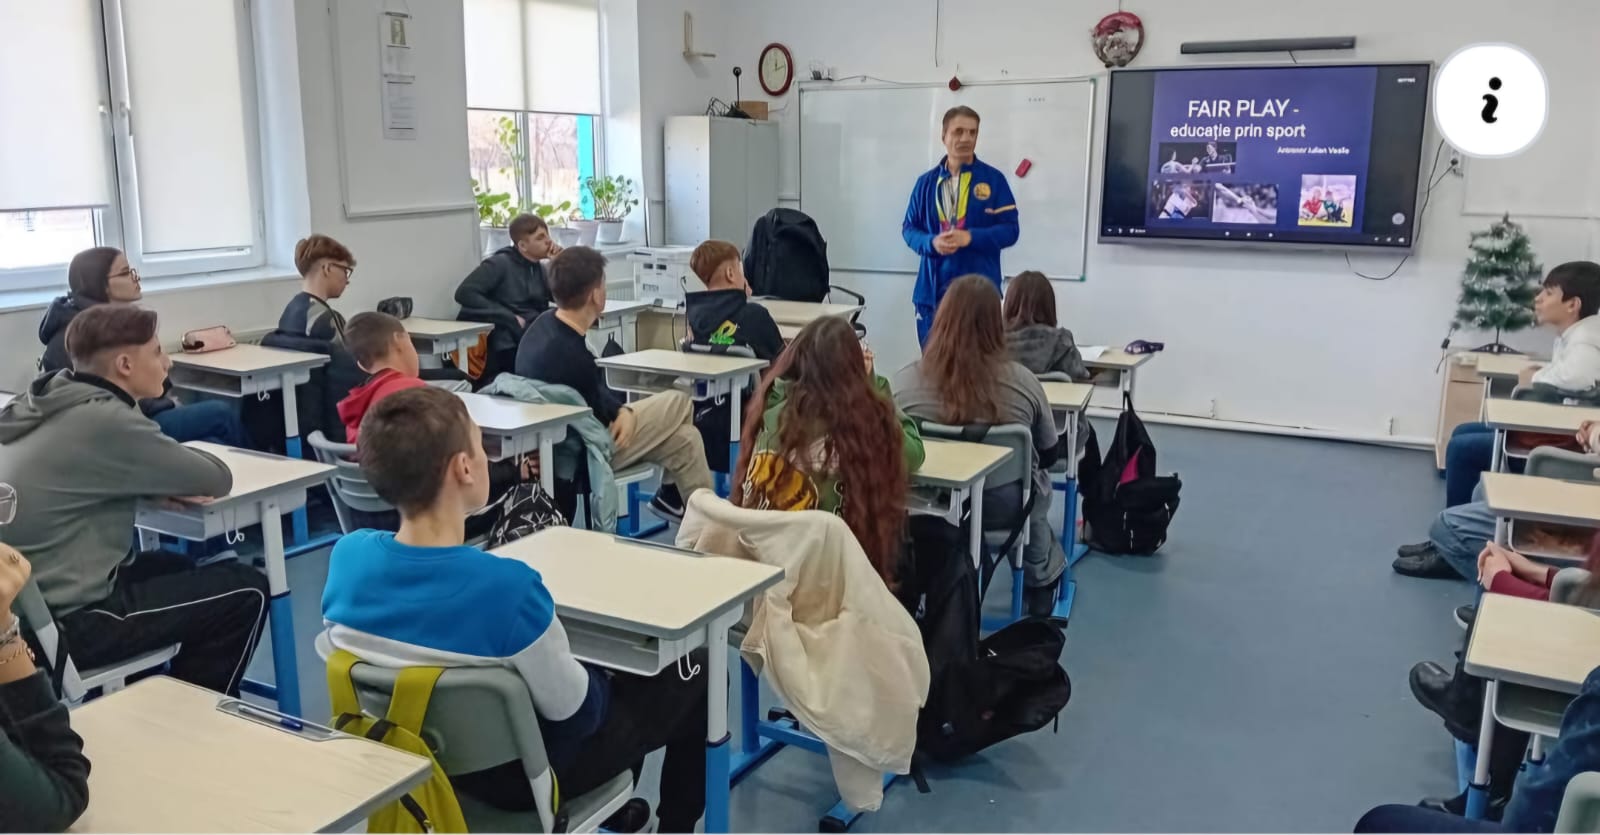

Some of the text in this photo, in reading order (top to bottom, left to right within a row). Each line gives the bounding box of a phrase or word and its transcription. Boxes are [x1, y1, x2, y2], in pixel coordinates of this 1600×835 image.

[1188, 99, 1231, 118] FAIR
[1236, 98, 1290, 118] PLAY
[1234, 123, 1262, 140] prin
[1266, 124, 1306, 140] sport
